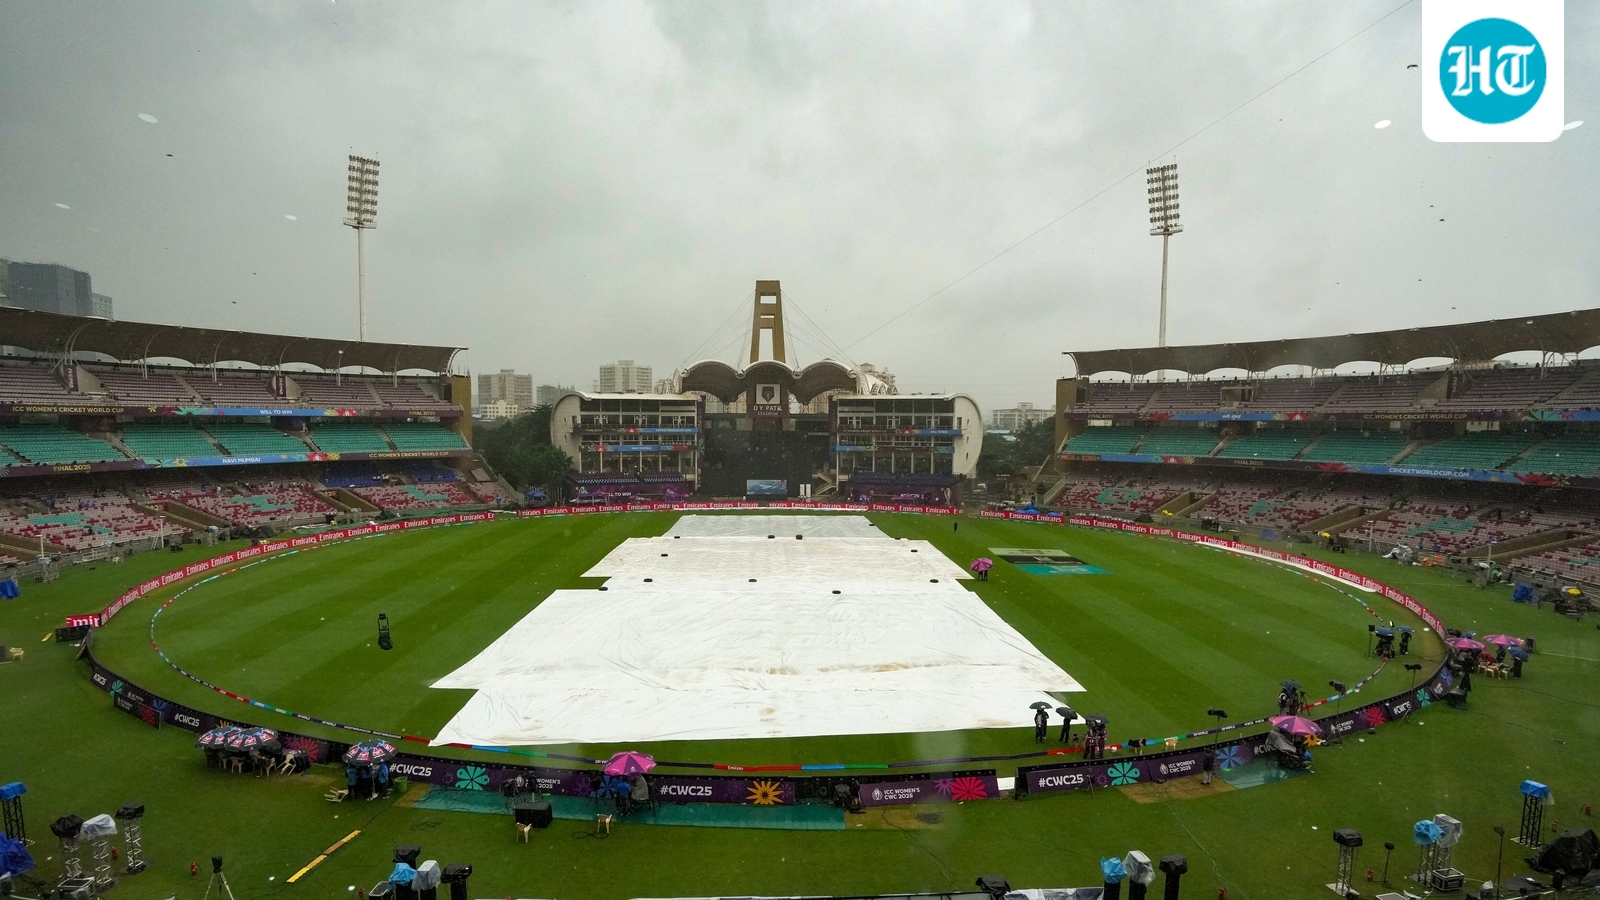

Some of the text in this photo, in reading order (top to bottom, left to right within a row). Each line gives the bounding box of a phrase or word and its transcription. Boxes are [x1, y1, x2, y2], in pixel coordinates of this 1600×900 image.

[1389, 467, 1469, 478] CRICKETWORLDCUP.COM
[123, 589, 139, 606] Emirates
[140, 579, 159, 595] Emirates
[162, 570, 184, 585] Emirates
[186, 561, 209, 576] Emirates
[211, 554, 233, 568] Emirates
[236, 546, 260, 559] Emirates
[263, 541, 288, 553] Emirates
[292, 536, 316, 547] Emirates
[319, 531, 344, 541] Emirates
[348, 526, 372, 536] Emirates
[375, 522, 400, 532] Emirates
[404, 519, 429, 528] Emirates
[431, 516, 456, 524] Emirates
[460, 513, 485, 521] Emirates
[1093, 520, 1118, 529] Emirates
[1122, 524, 1147, 533] Emirates
[1177, 532, 1201, 542] Emirates
[1204, 536, 1228, 546] Emirates
[1232, 542, 1256, 553] Emirates
[1258, 548, 1282, 560] Emirates
[1286, 554, 1310, 568] Emirates
[1313, 561, 1336, 576] Emirates
[1338, 568, 1360, 584] Emirates
[1362, 577, 1382, 593] Emirates
[1385, 587, 1404, 604] Emirates
[1405, 597, 1422, 616] Emirates
[174, 713, 199, 727] #CWC25
[1254, 745, 1276, 755] #CWC
[389, 763, 432, 777] #CWC25
[1038, 774, 1084, 787] #CWC25
[660, 785, 712, 796] #CWC25
